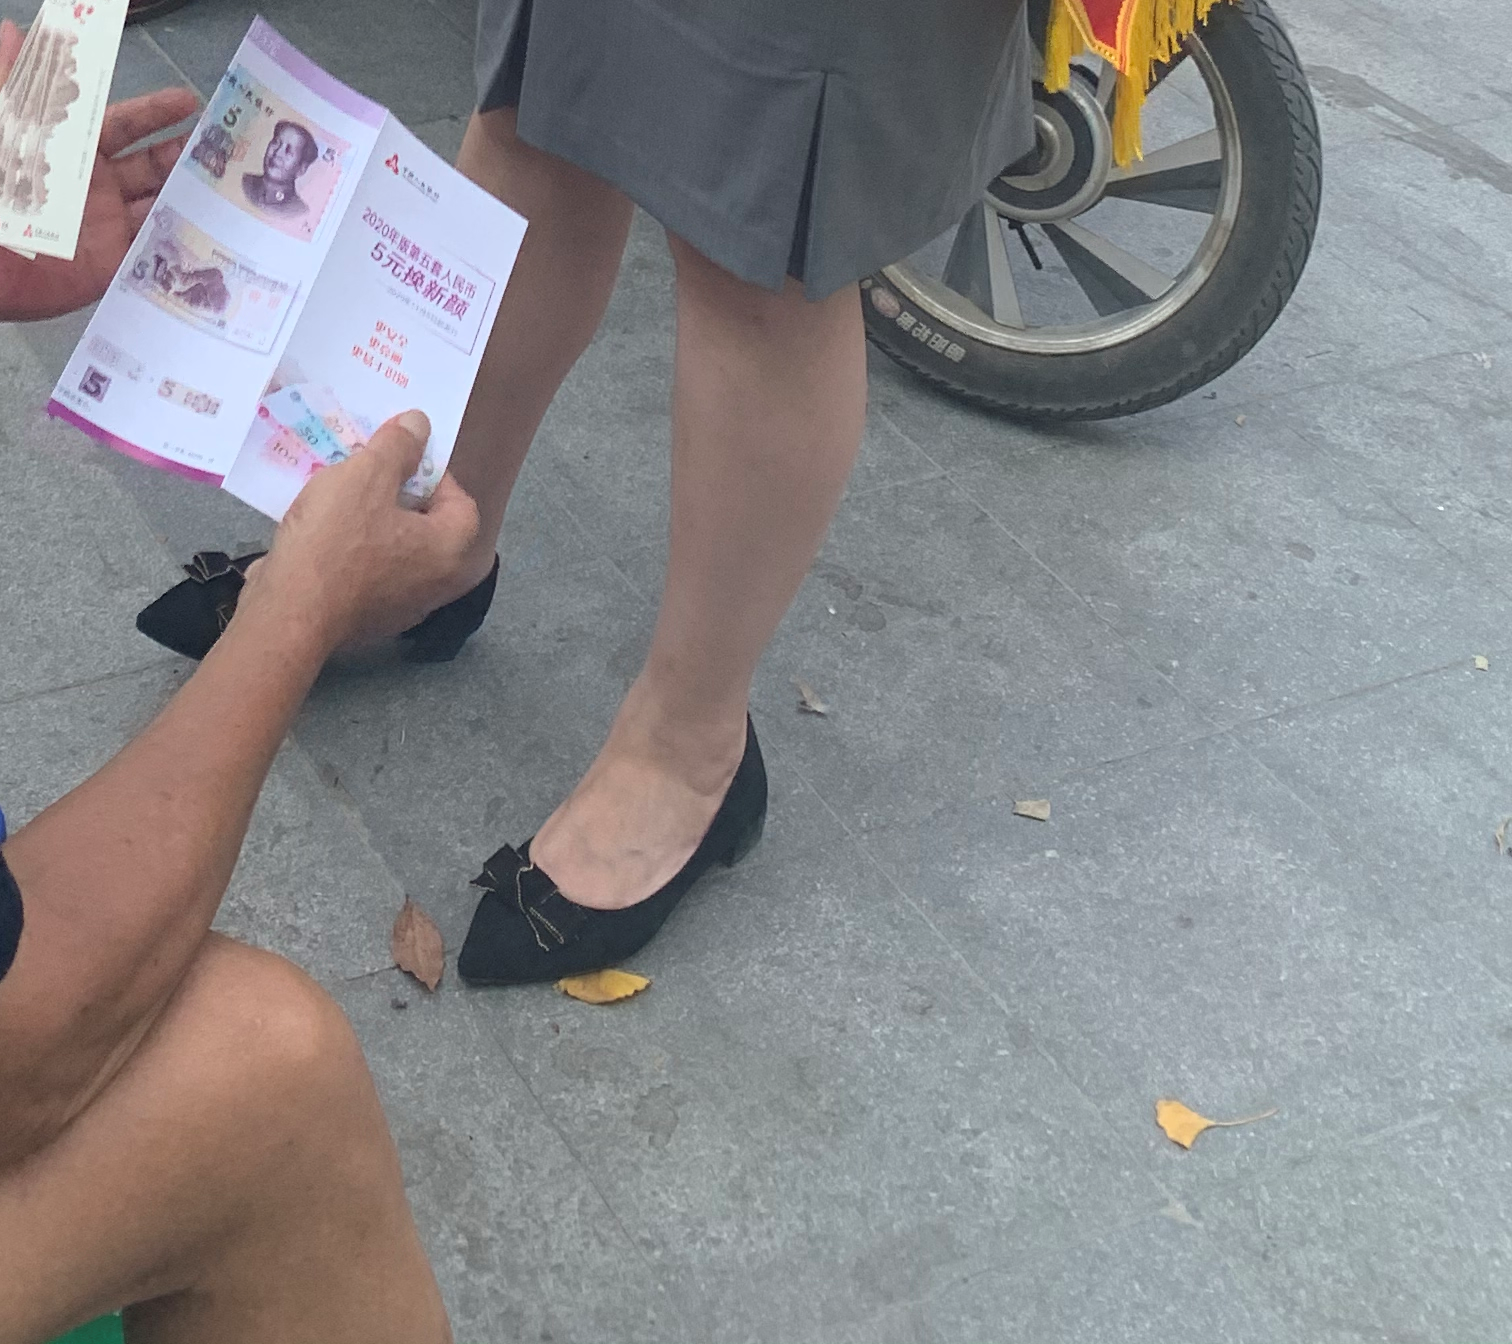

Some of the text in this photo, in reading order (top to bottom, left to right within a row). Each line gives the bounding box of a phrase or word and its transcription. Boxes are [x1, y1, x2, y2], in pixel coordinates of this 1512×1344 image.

[362, 207, 477, 299] 2020年版第五套人民币
[370, 241, 471, 321] 5元换新颜
